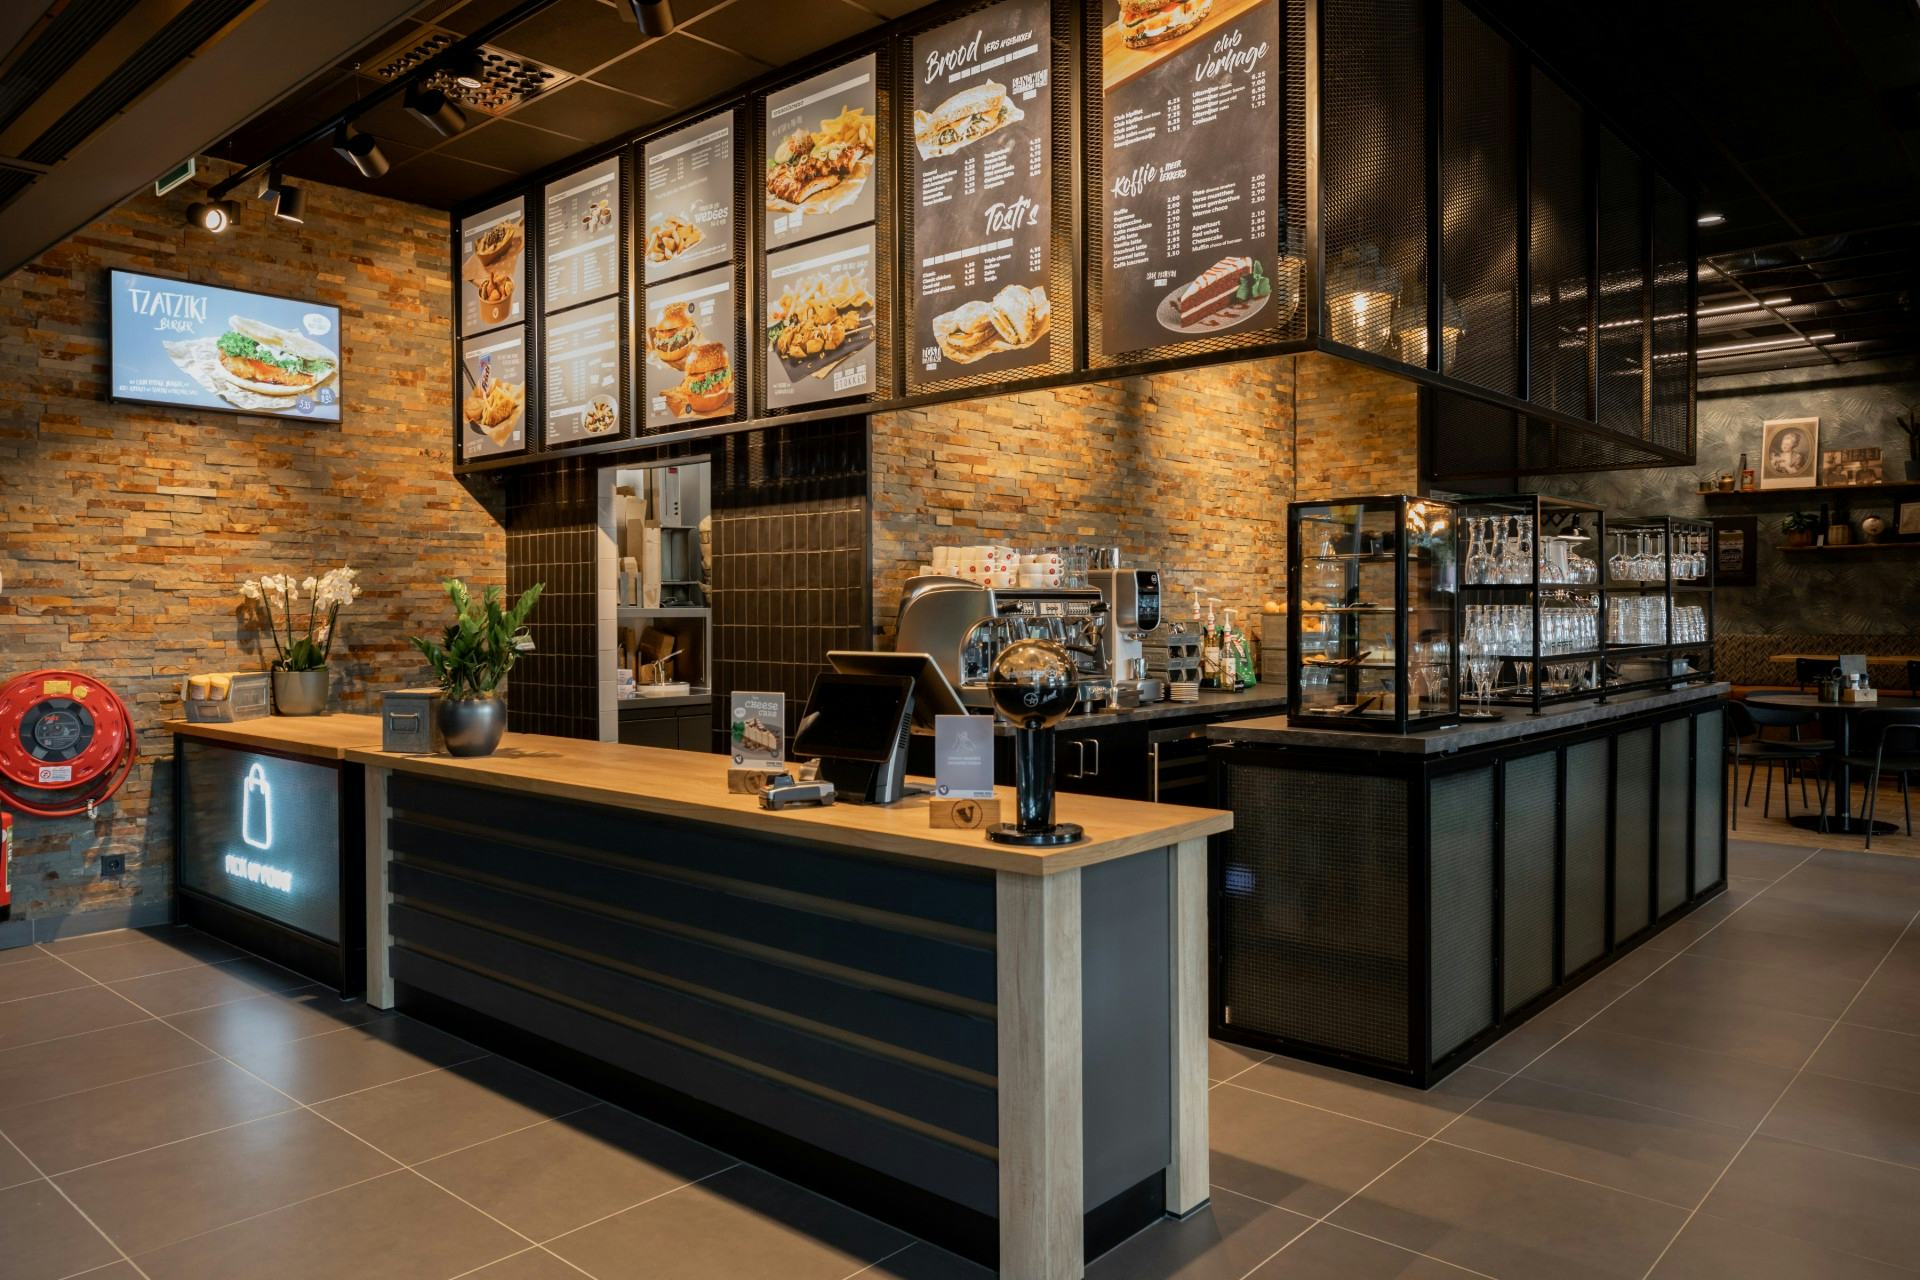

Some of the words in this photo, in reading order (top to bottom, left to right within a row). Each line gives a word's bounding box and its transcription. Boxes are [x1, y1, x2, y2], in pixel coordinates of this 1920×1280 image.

[925, 30, 983, 84] Brood
[1195, 42, 1269, 81] Verhage
[1111, 164, 1158, 198] Koffie
[128, 288, 208, 323] TZATZIKI
[154, 318, 195, 334] BURGER
